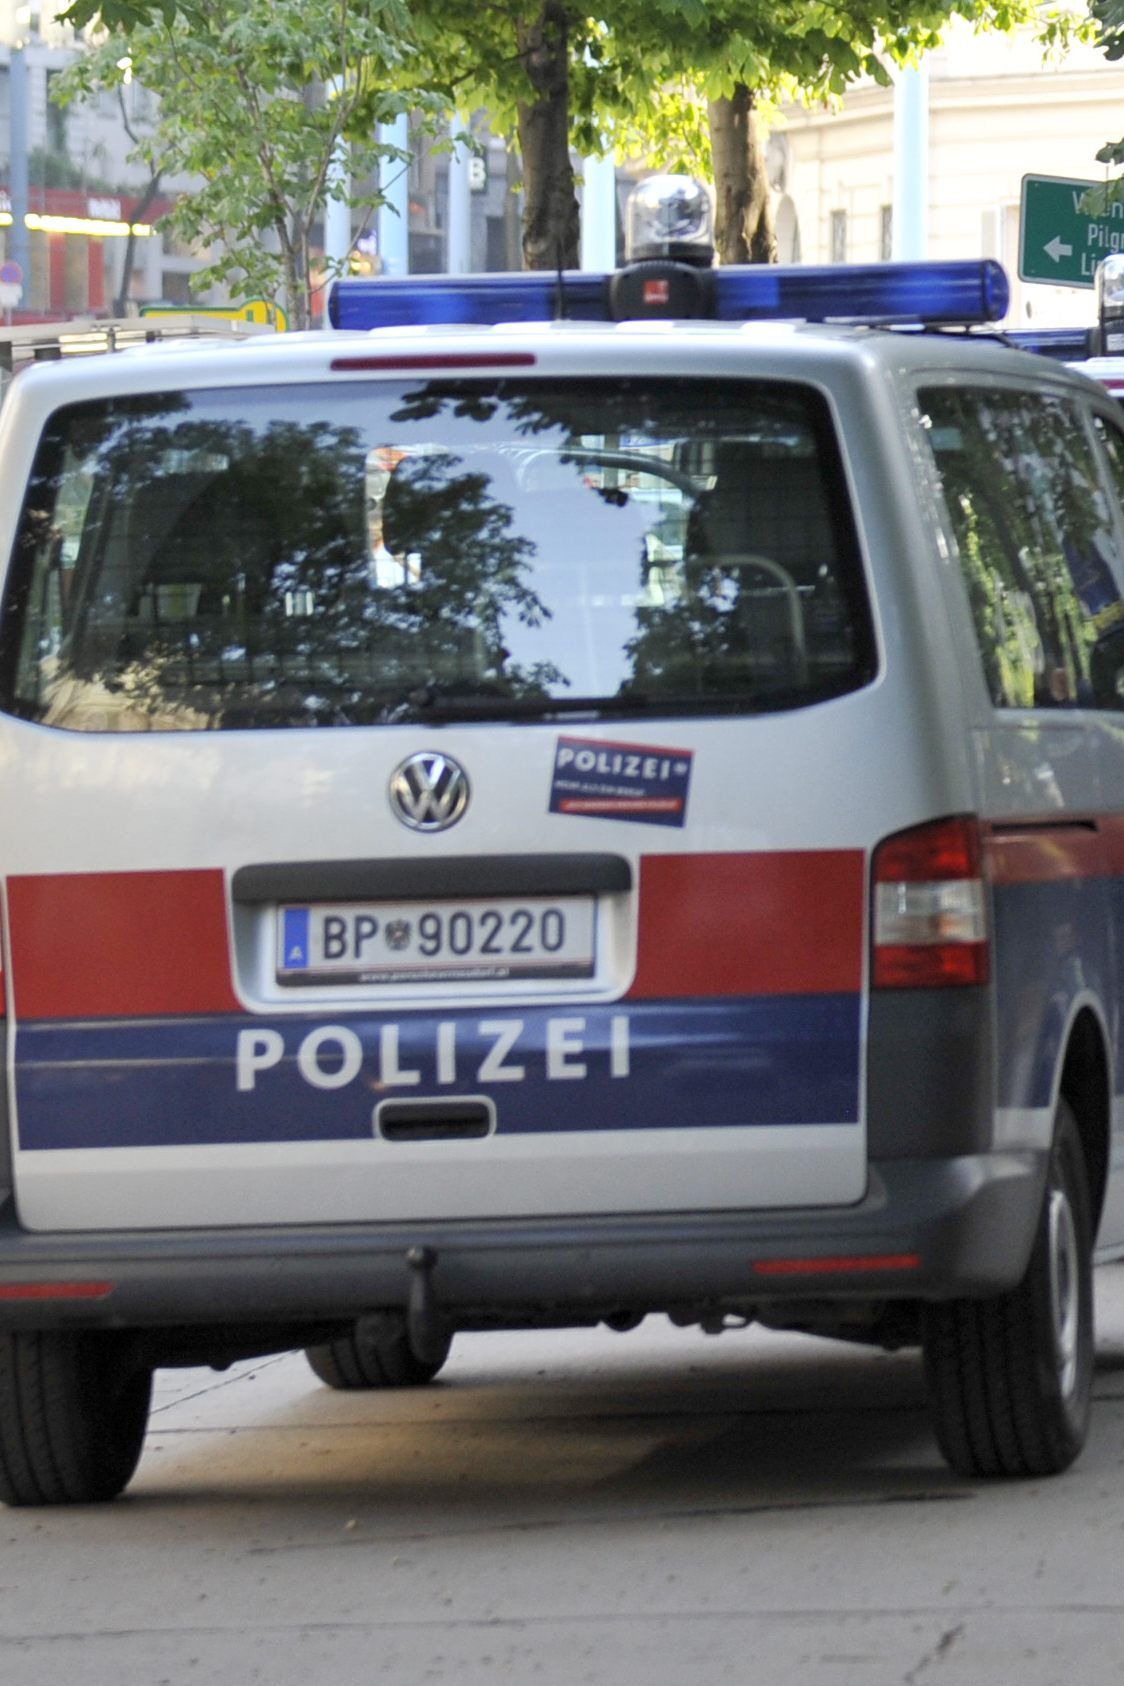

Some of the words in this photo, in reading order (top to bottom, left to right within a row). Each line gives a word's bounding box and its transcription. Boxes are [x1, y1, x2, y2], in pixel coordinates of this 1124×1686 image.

[323, 914, 379, 960] BP
[418, 907, 565, 957] 90220
[236, 1015, 631, 1092] POLIZEI
